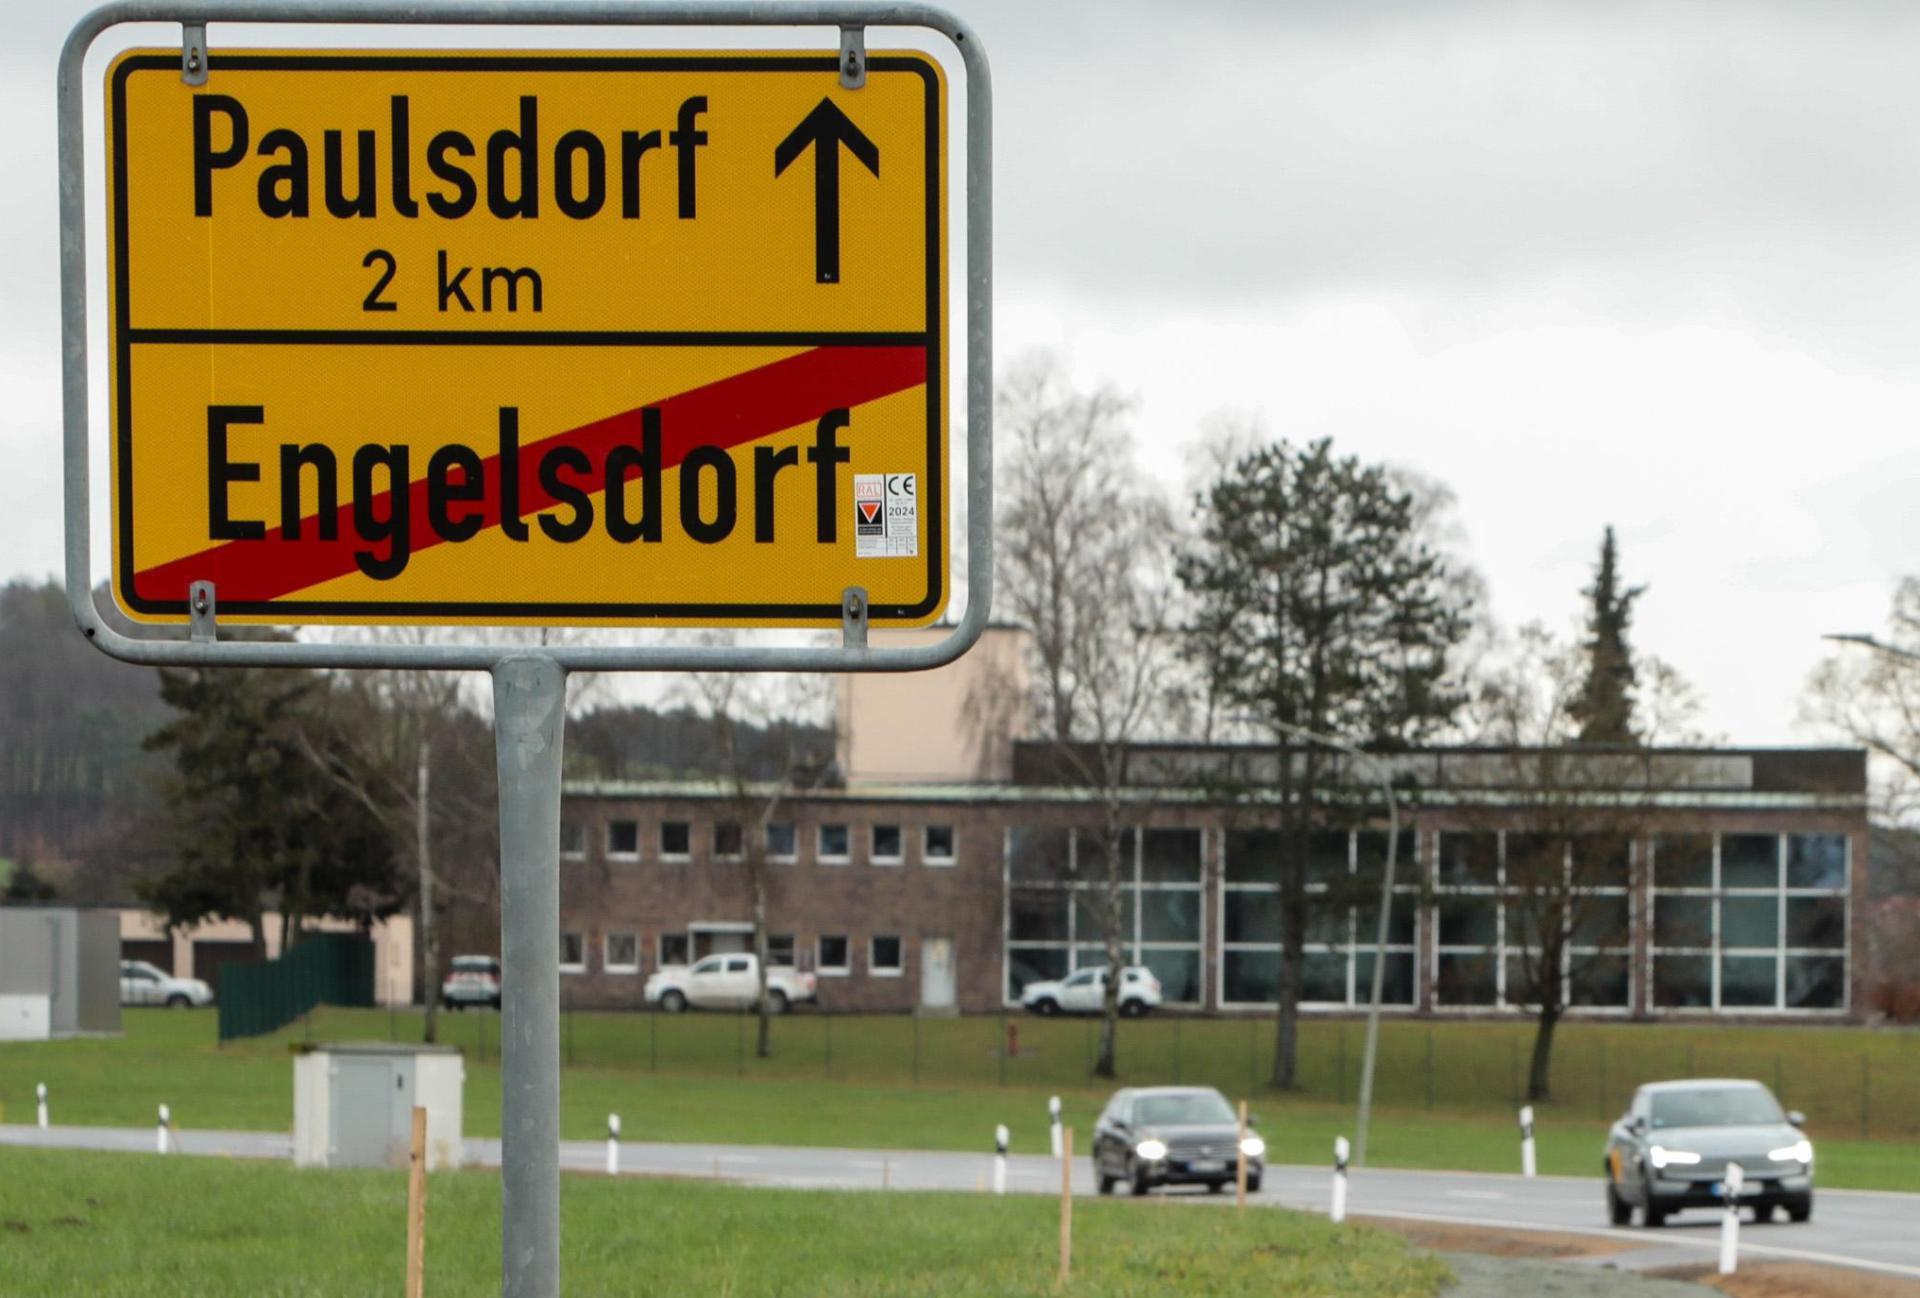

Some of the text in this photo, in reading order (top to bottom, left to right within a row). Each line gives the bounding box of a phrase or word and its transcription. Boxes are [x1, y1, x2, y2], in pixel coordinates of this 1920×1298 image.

[193, 95, 708, 219] Paulsdorf
[362, 249, 543, 312] 2 km
[207, 405, 851, 580] Engelsdorf
[858, 485, 880, 497] RAL
[888, 475, 915, 496] CE
[888, 506, 915, 517] 2024
